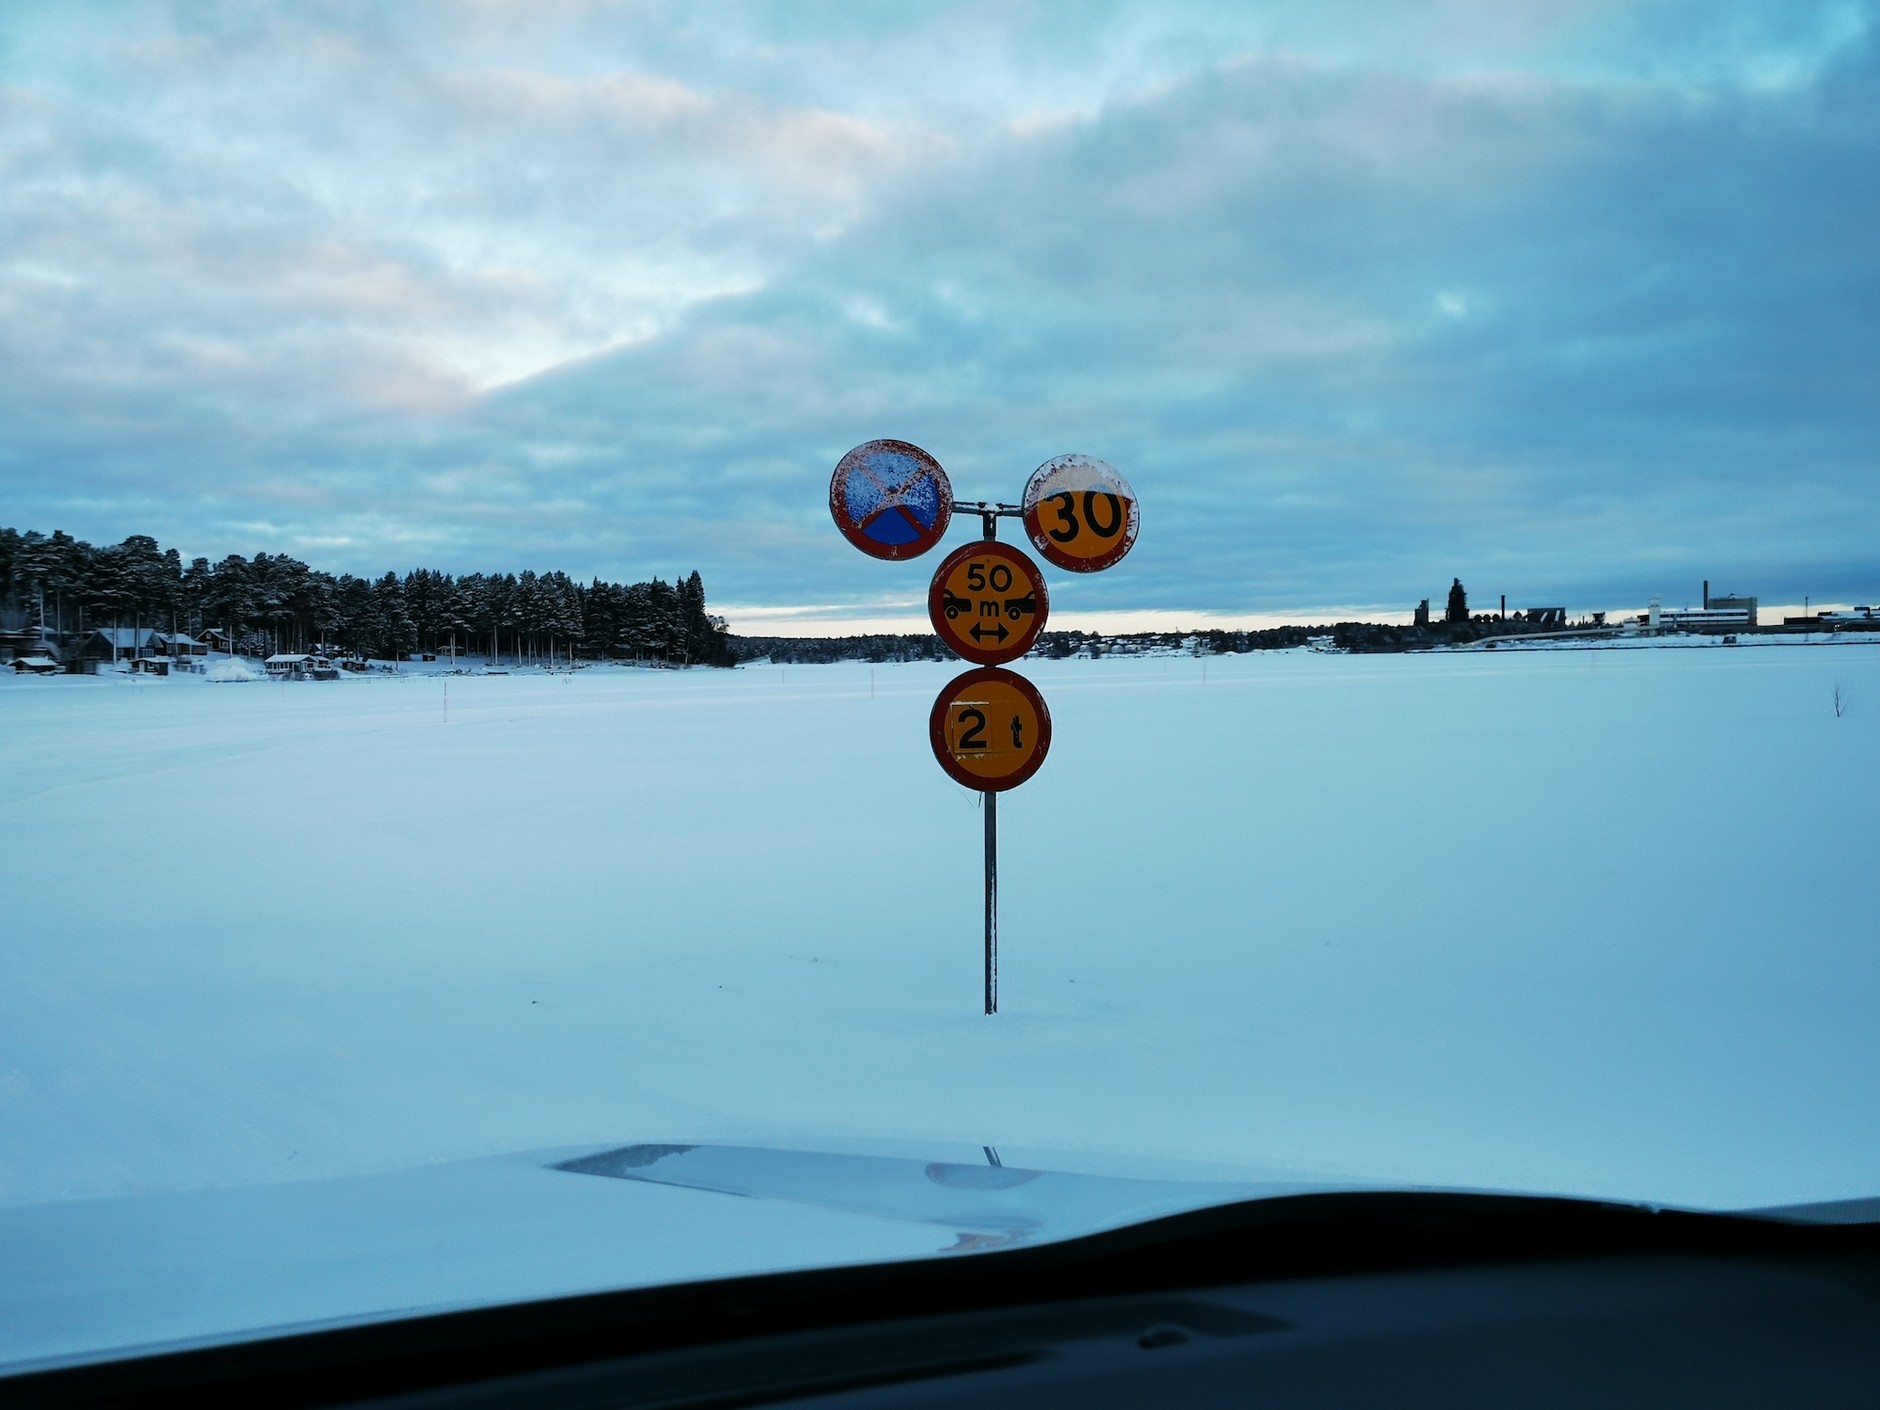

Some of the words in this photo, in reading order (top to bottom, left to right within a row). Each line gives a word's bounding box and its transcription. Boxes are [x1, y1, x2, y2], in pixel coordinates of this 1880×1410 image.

[1045, 490, 1122, 543] 30
[967, 563, 1013, 592] 50
[980, 600, 1000, 617] m
[957, 708, 988, 749] 2
[1010, 714, 1023, 748] t
